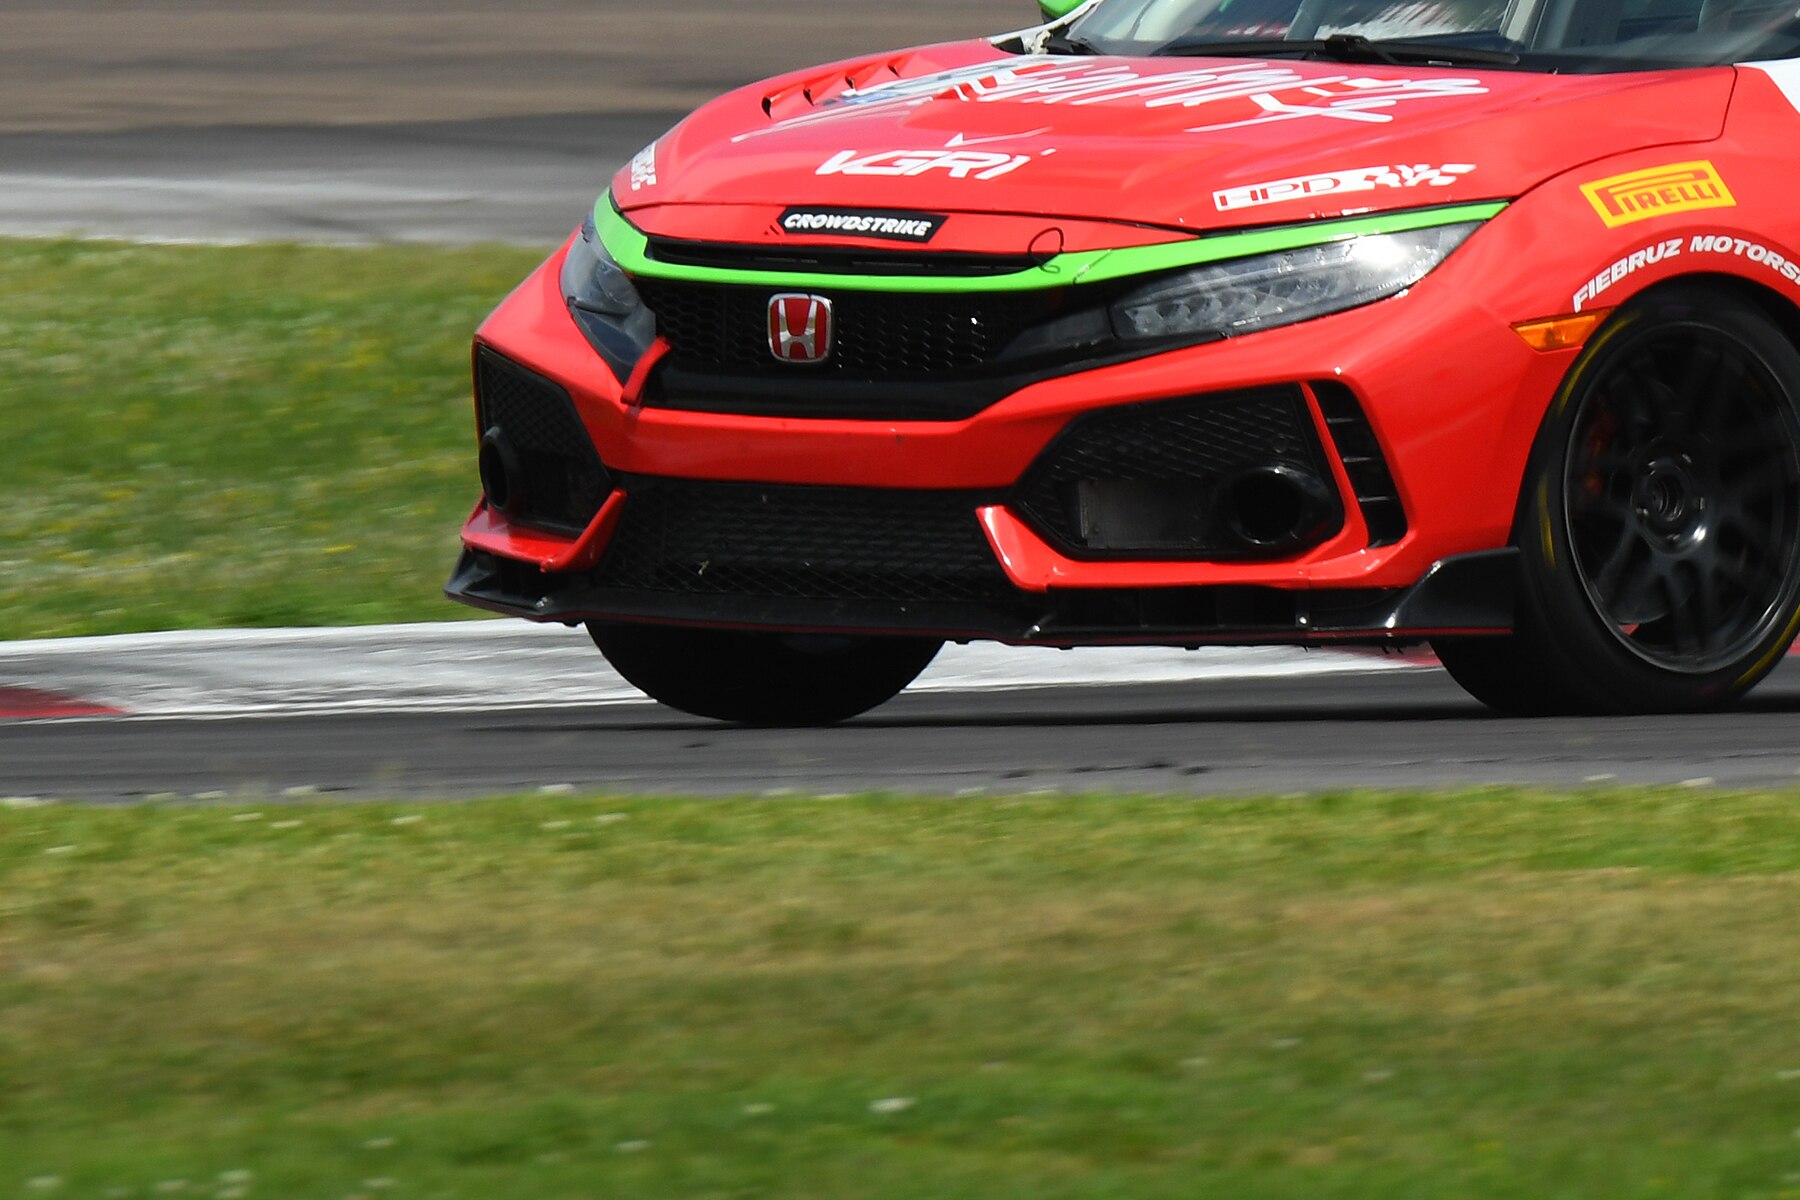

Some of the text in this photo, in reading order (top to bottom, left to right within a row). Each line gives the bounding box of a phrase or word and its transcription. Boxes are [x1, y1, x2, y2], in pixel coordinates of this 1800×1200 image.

[1593, 171, 1721, 218] PIRELLI
[784, 214, 932, 237] CROWDSTRIKE
[1572, 237, 1683, 313] FIEBRUZ
